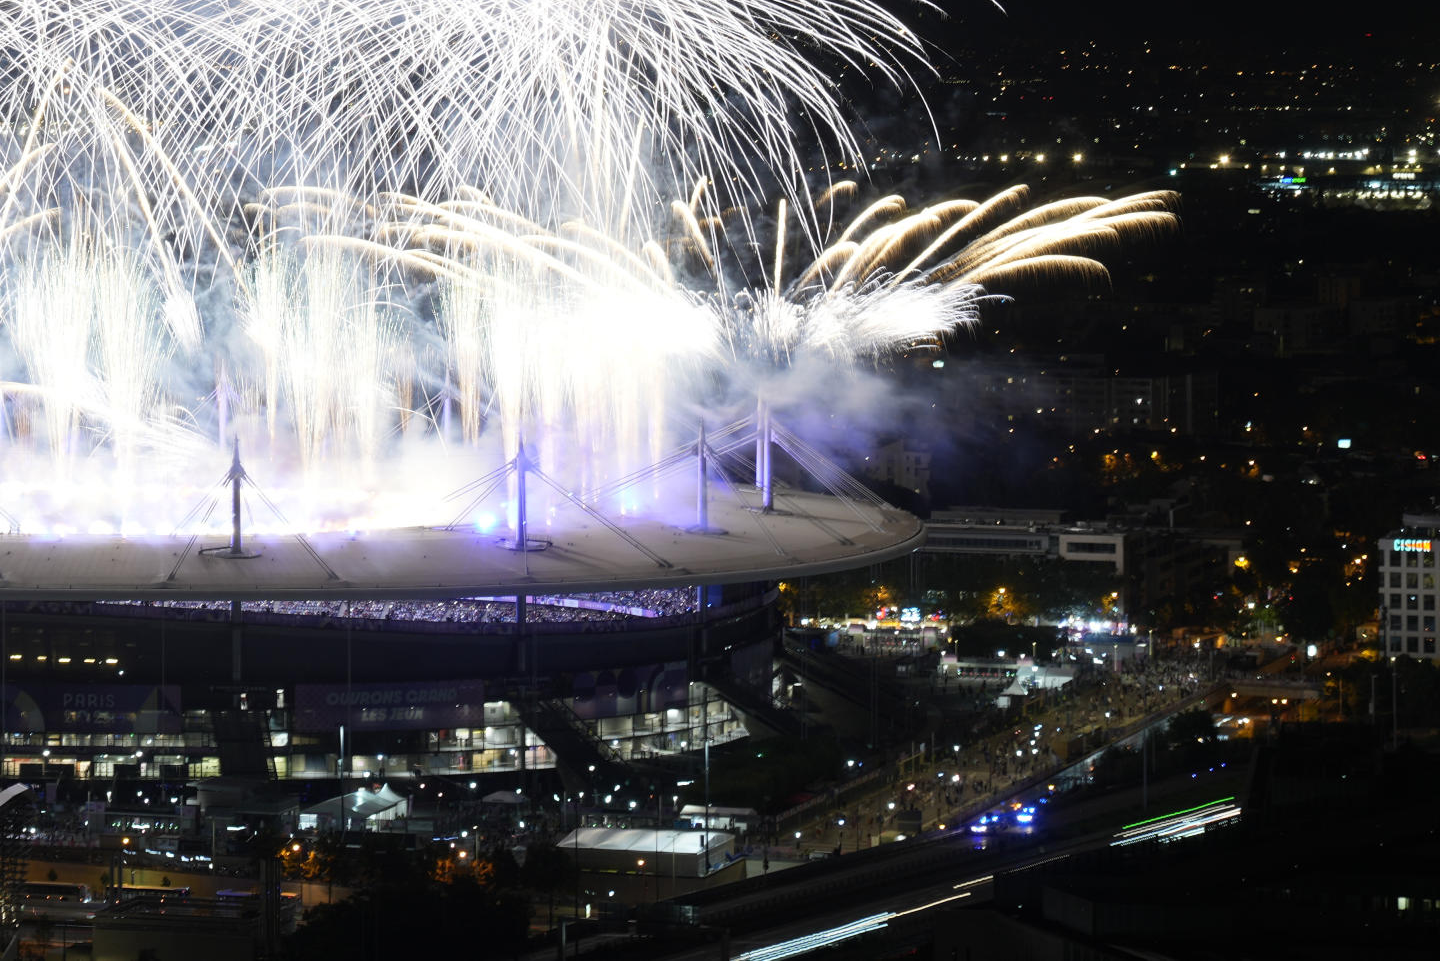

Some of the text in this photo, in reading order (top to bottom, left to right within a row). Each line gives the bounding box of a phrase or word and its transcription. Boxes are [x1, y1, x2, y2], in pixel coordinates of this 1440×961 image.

[1393, 538, 1432, 553] CISION
[63, 693, 115, 708] PARIS
[326, 688, 456, 705] OUVRONS GRAND
[361, 708, 387, 722] LES
